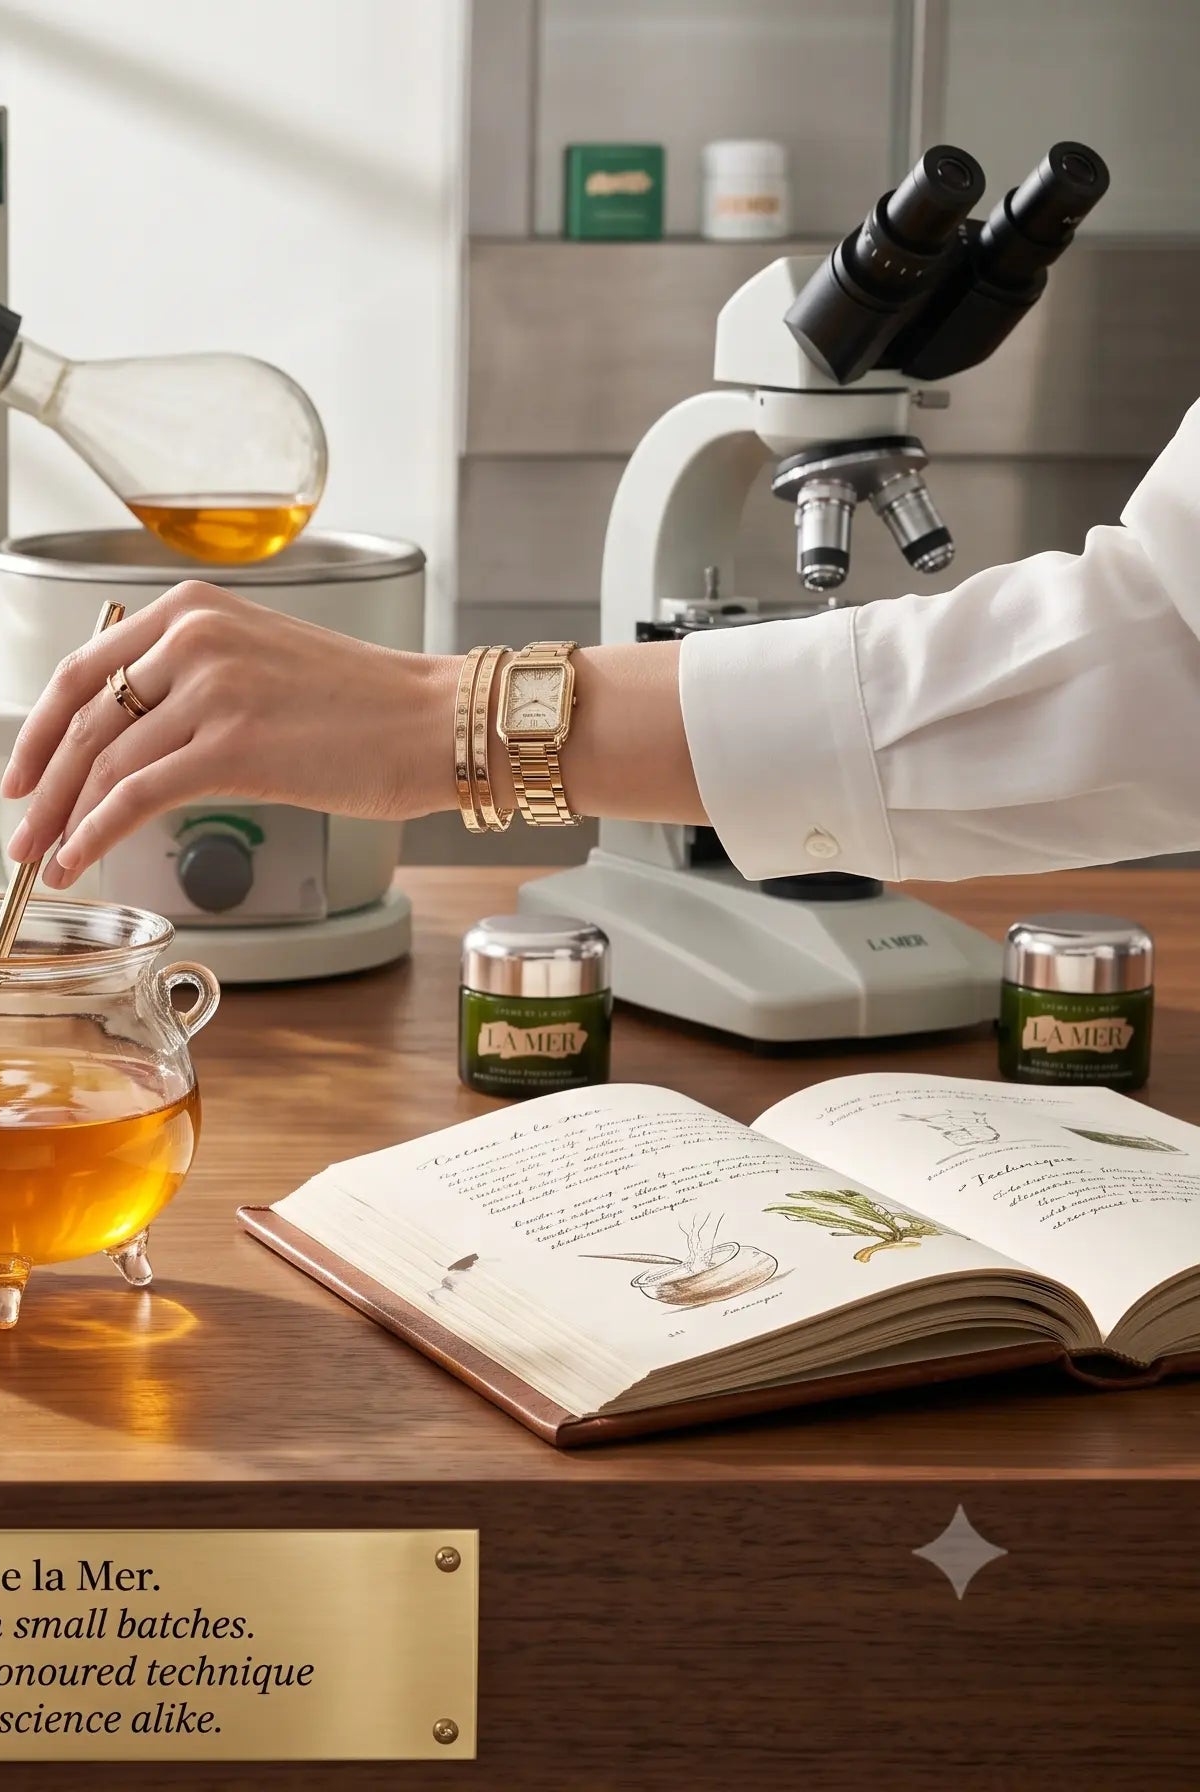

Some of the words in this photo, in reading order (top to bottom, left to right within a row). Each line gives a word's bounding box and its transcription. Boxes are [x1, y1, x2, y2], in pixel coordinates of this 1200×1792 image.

[866, 938, 894, 952] LA
[890, 933, 929, 949] MER
[487, 1028, 517, 1051] LA
[524, 1031, 577, 1052] MER
[1032, 1021, 1063, 1045] LA
[1071, 1026, 1124, 1047] MER
[31, 1558, 66, 1592] la
[76, 1560, 161, 1592] Mer.
[13, 1607, 108, 1640] small
[116, 1607, 256, 1640] batches.
[146, 1654, 315, 1695] technique
[131, 1701, 223, 1735] alike.
